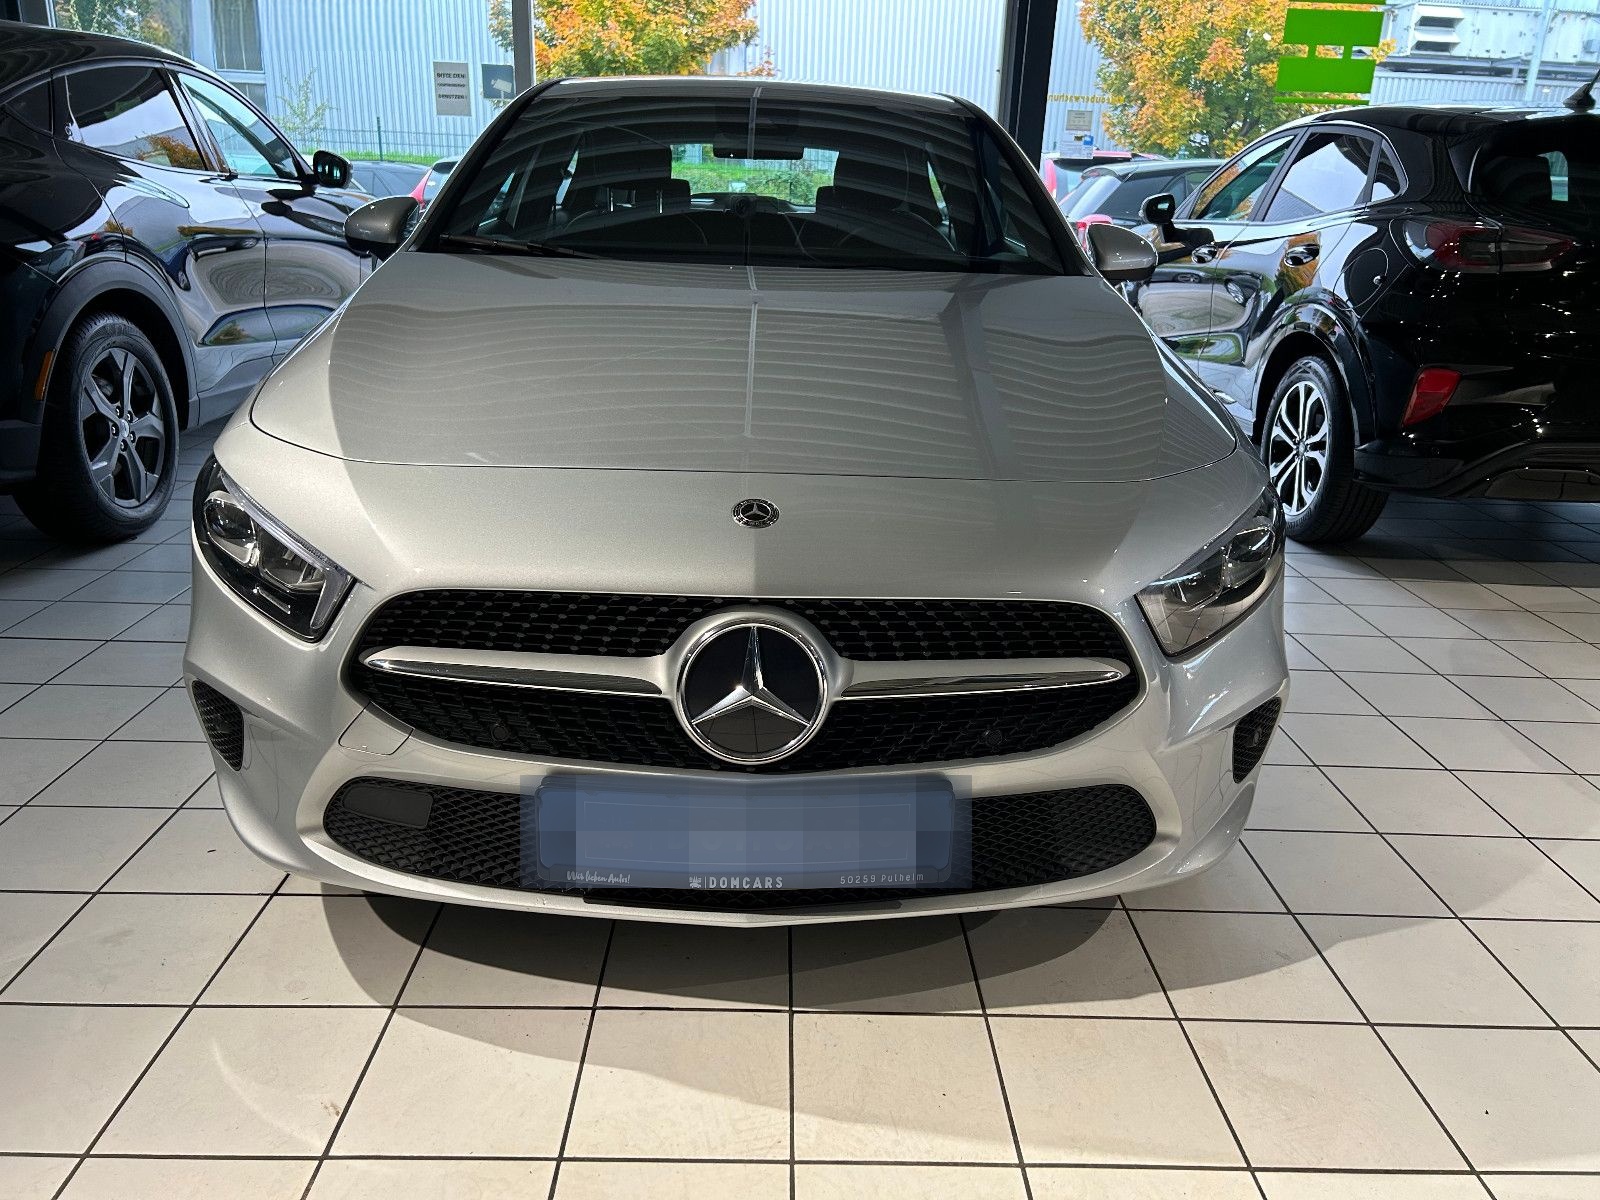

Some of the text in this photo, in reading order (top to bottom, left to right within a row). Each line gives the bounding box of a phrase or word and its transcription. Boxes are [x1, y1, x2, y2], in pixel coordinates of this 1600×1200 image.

[566, 870, 631, 884] Wir lieben Autos!
[709, 876, 783, 889] DOMCARS
[840, 872, 924, 885] 50259 Pulheim
